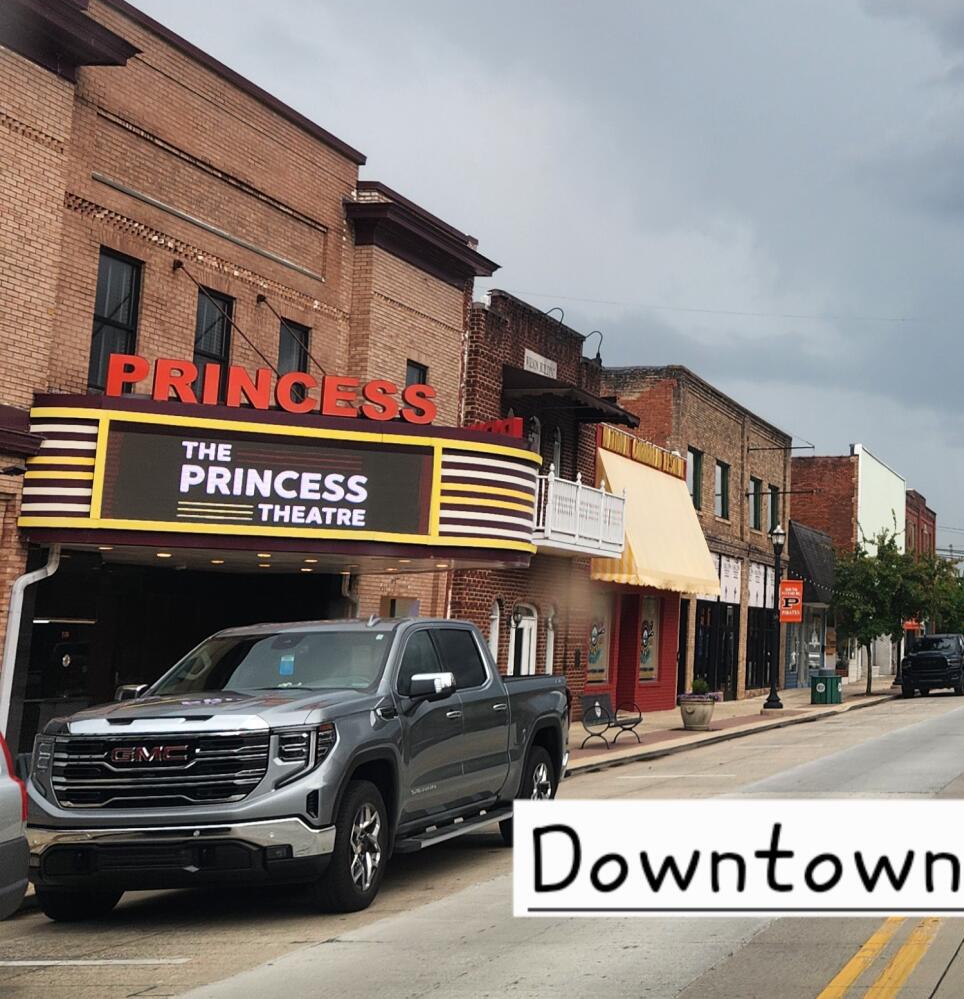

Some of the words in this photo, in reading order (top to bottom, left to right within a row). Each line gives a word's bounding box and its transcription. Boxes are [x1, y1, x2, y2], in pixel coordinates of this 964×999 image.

[105, 353, 437, 425] PRINCESS
[182, 441, 232, 461] THE
[180, 464, 368, 503] PRINCESS
[258, 503, 366, 526] THEATRE
[111, 745, 190, 762] GMC
